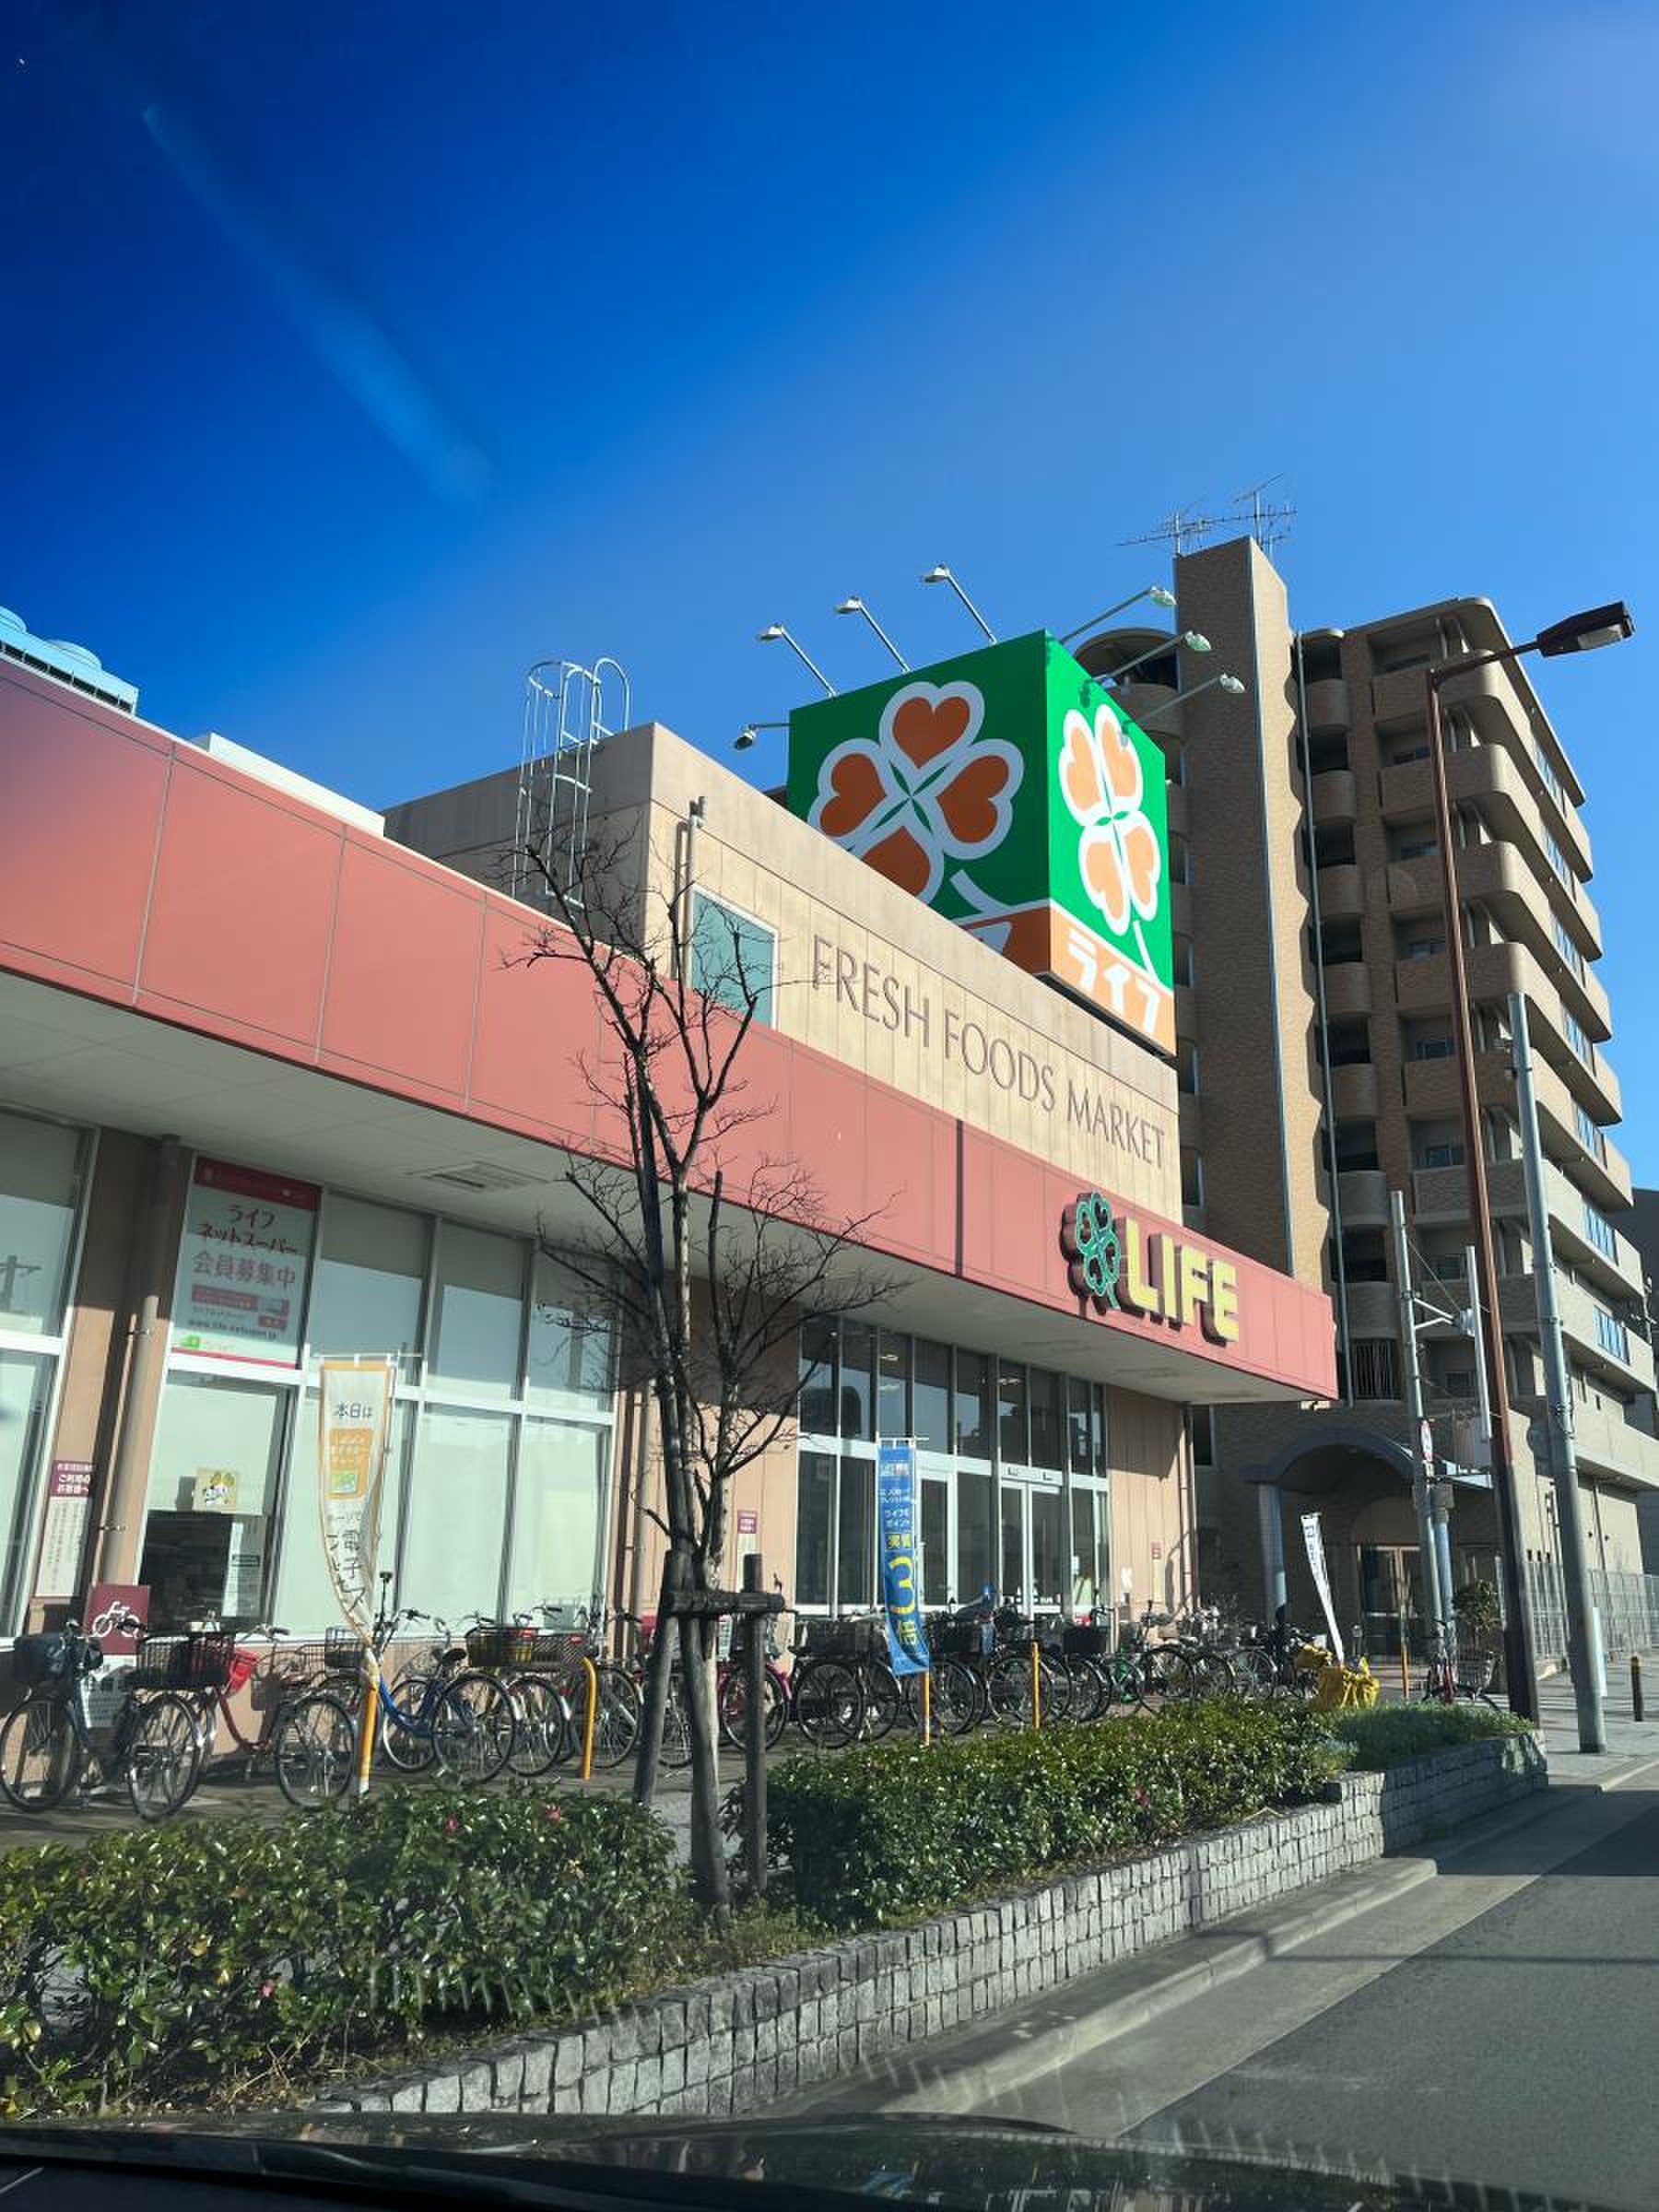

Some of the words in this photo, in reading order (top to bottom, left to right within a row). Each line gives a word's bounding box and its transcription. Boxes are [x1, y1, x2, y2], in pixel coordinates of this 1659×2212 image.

[1067, 928, 1160, 1034] ライフ
[811, 934, 930, 1049] FRESH
[944, 1007, 1055, 1113] FOODS
[1065, 1077, 1165, 1170] MARKET
[195, 1221, 297, 1254] ネットスーパー
[227, 1204, 276, 1230] ライフ
[192, 1251, 296, 1288] 会員募集中
[1123, 1216, 1241, 1344] LIFE
[333, 1401, 373, 1418] 本日は
[888, 1555, 914, 1615] 3
